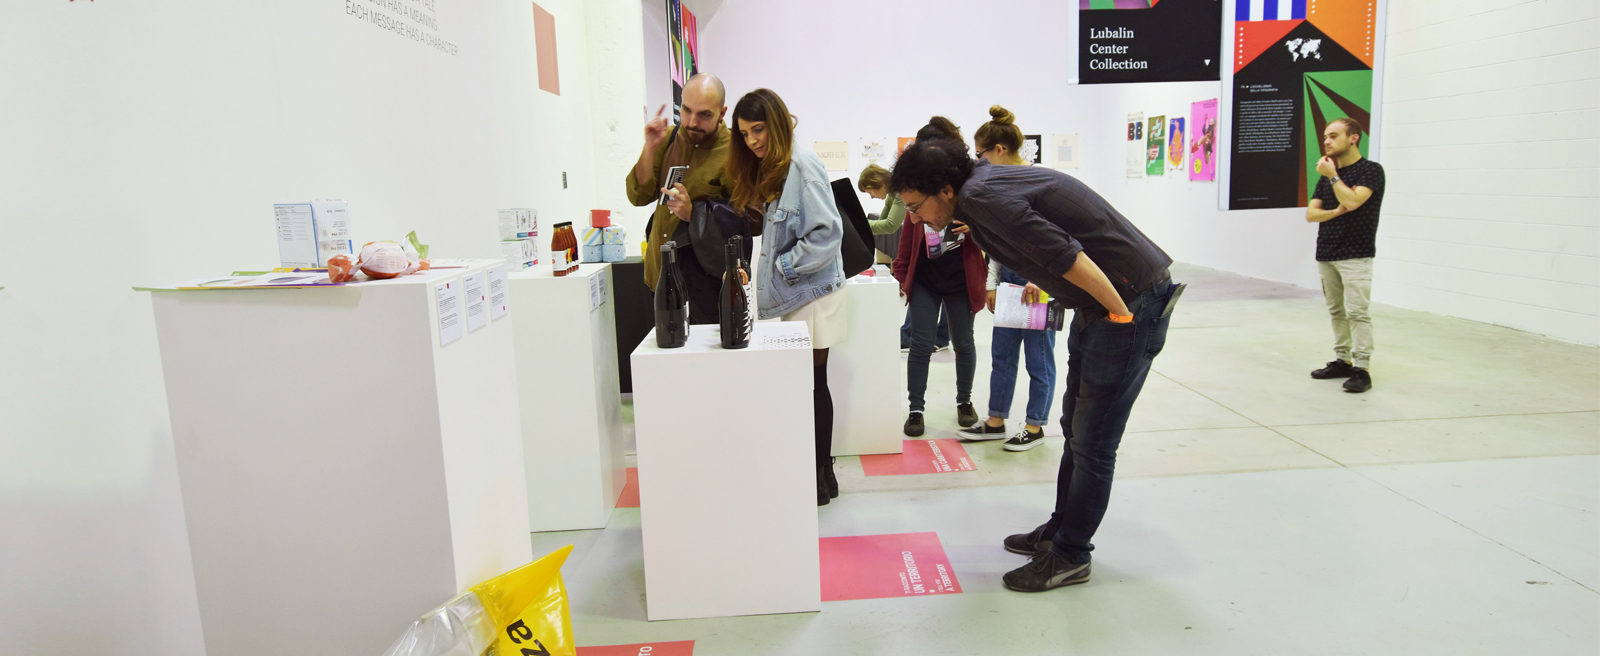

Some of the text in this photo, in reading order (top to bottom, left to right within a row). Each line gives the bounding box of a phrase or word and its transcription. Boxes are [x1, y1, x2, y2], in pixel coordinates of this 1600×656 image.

[346, 0, 369, 22] EACH
[370, 10, 405, 36] MESSAGE
[405, 25, 420, 42] HAS
[425, 33, 459, 56] CHARACTER
[409, 7, 439, 31] MEANING
[1090, 27, 1134, 39] Lubalin
[1090, 43, 1129, 54] Center
[1090, 58, 1148, 70] Collection
[901, 550, 926, 594] UN TERRITORIO
